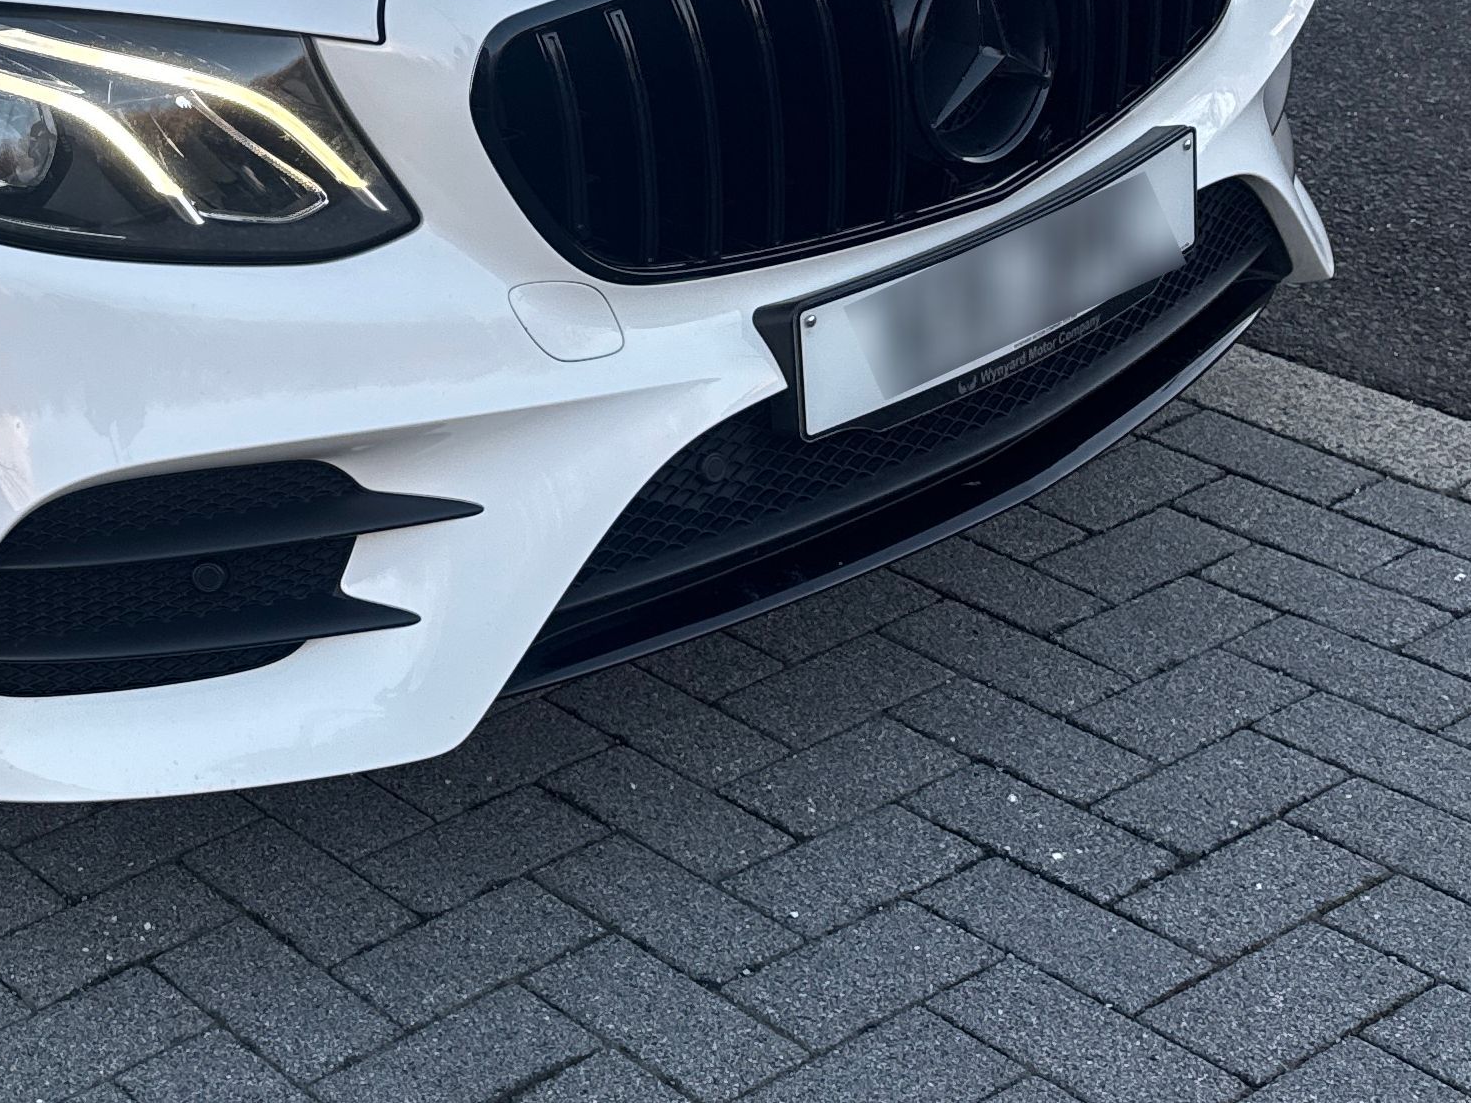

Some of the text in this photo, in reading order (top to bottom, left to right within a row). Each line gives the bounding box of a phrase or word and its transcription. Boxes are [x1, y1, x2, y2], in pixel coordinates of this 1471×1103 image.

[980, 351, 1027, 383] Wynyard
[1029, 337, 1058, 361] Motor
[1058, 314, 1101, 345] Company
